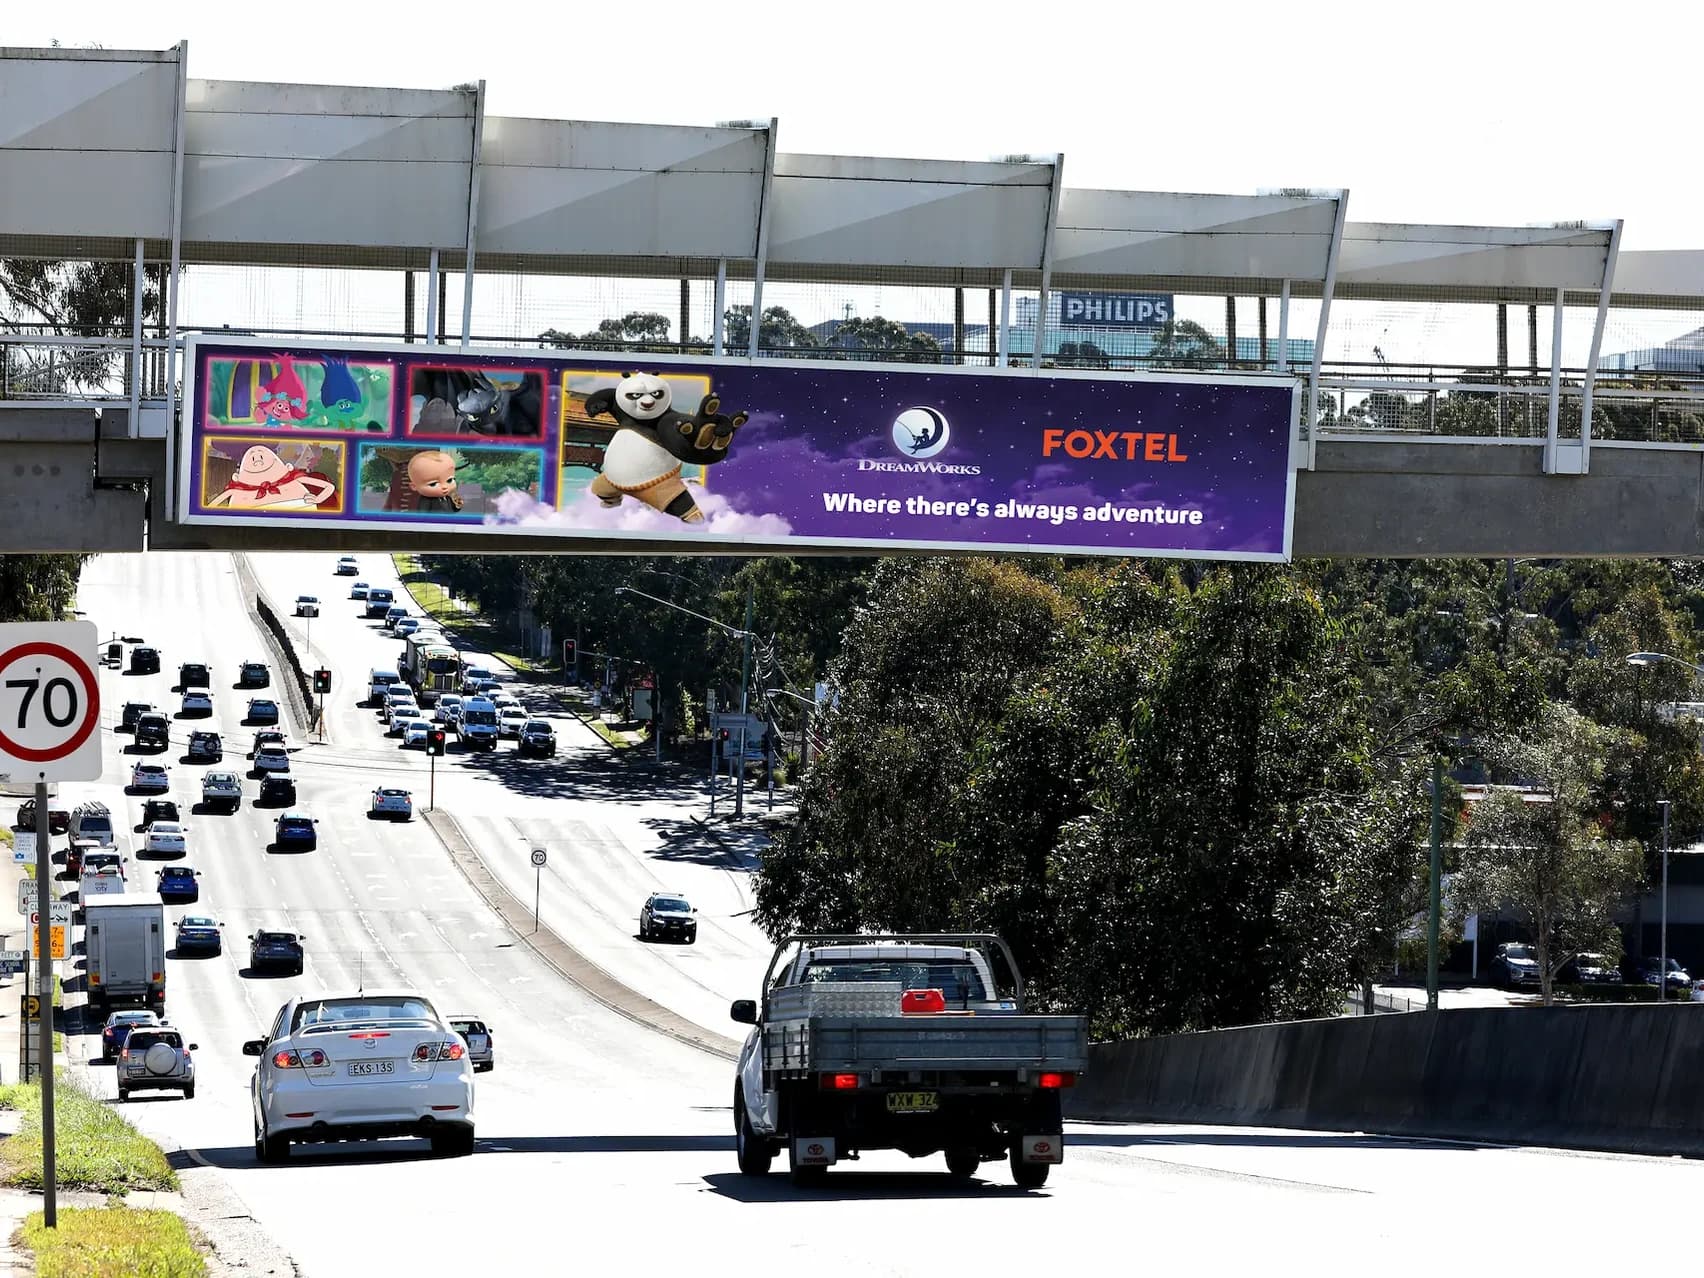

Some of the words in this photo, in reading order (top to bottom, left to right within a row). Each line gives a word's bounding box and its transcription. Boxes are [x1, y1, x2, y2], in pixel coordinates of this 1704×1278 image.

[1067, 298, 1168, 322] PHILIPS
[1042, 429, 1188, 462] FOXTEL
[823, 492, 901, 514] Where
[906, 495, 990, 518] there's
[994, 498, 1078, 525] always
[1082, 502, 1203, 525] adventure
[6, 677, 78, 728] 70
[353, 1064, 371, 1074] EKS
[889, 1093, 913, 1107] WXW
